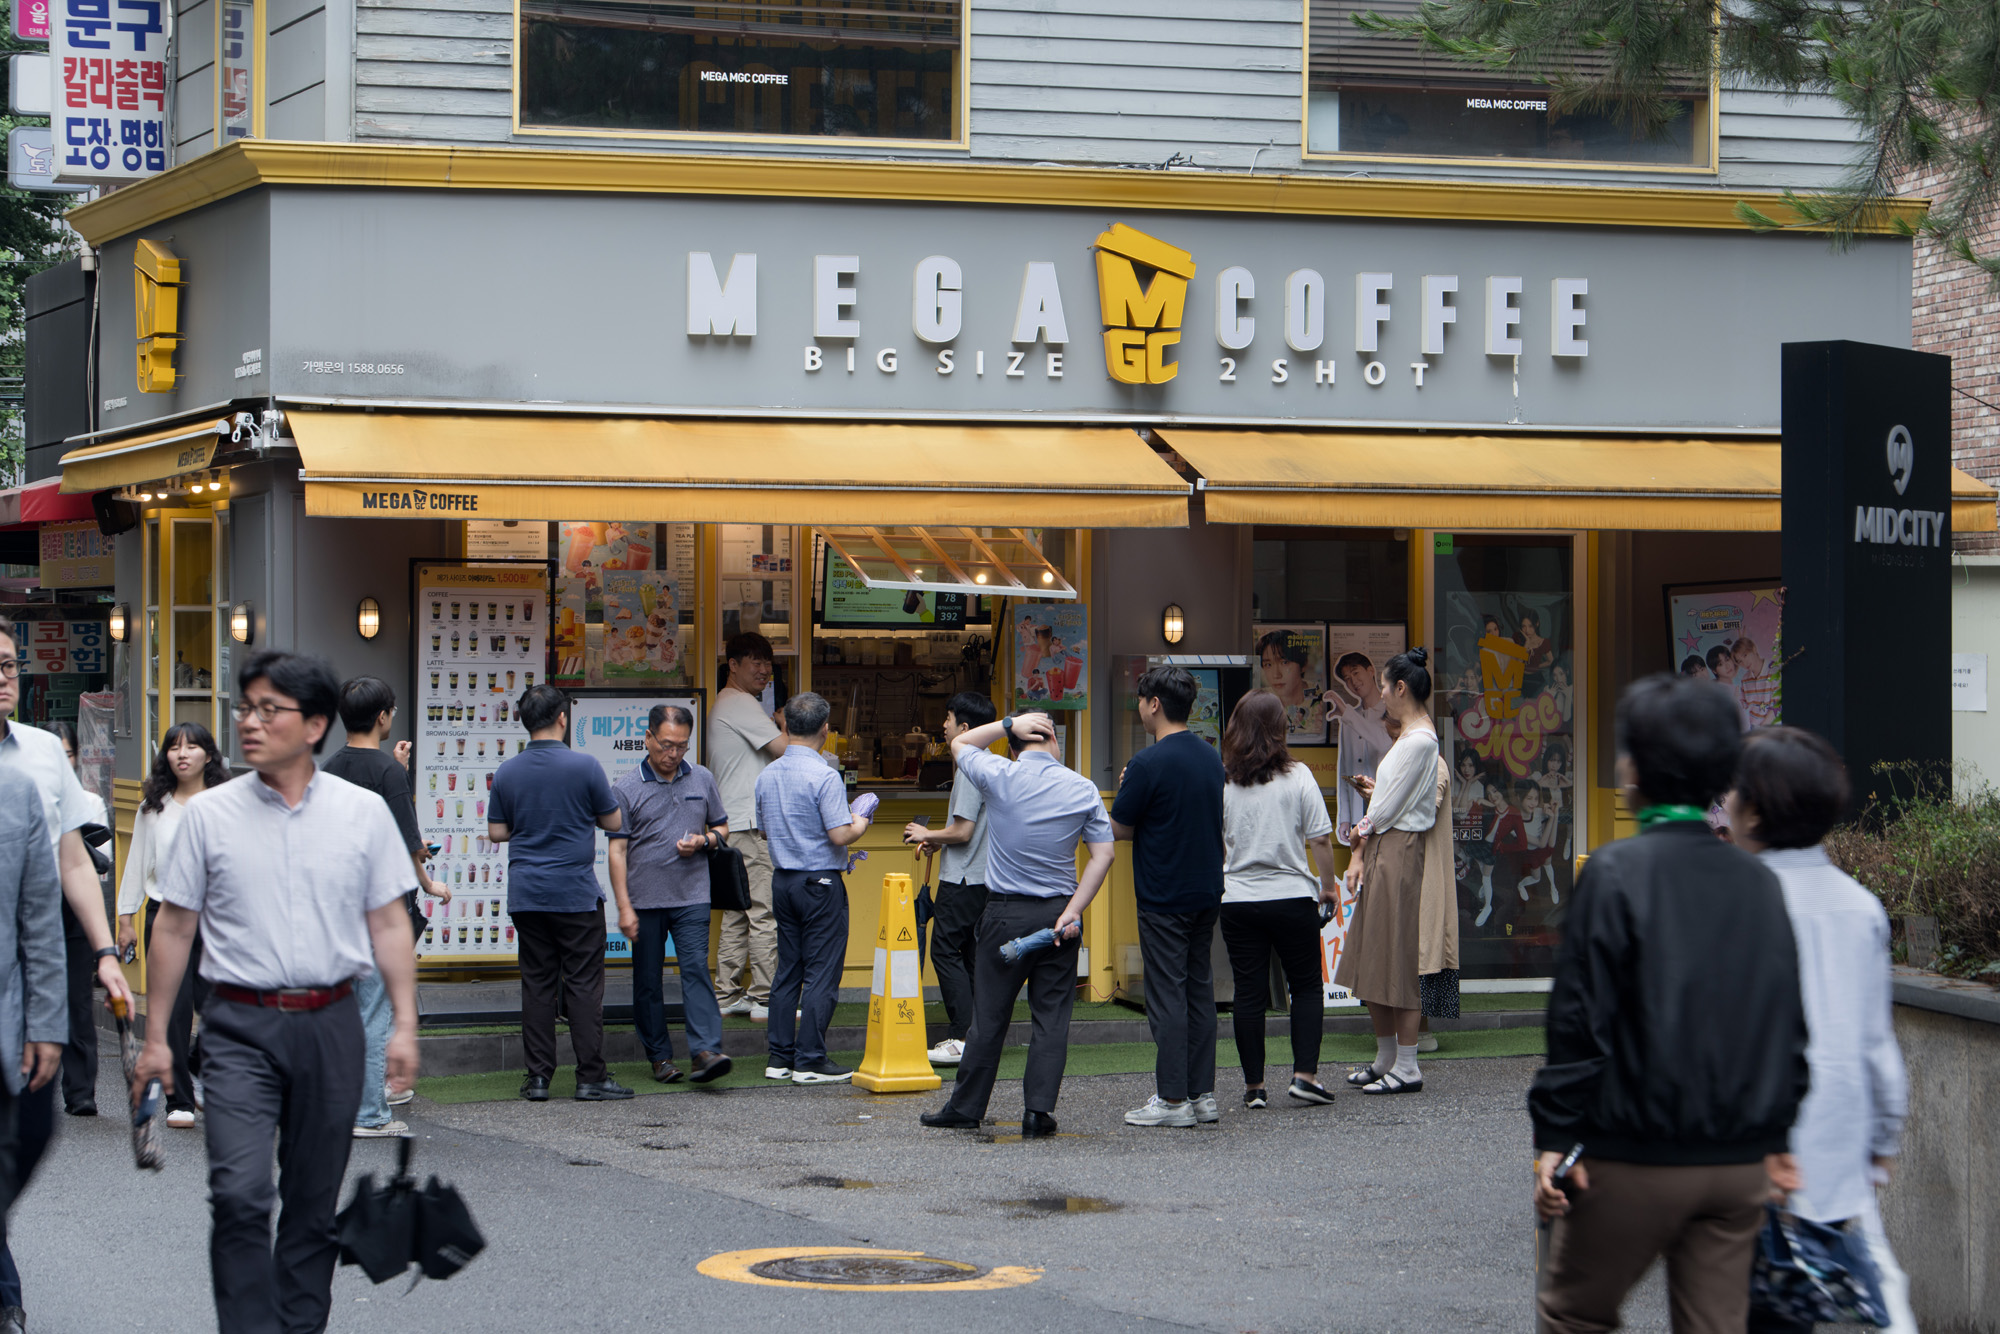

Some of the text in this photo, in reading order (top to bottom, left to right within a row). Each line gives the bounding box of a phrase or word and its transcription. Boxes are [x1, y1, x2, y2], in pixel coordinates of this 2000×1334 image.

[29, 2, 48, 24] 올
[65, 0, 162, 51] 문구
[63, 57, 164, 111] 칼라출력
[700, 71, 788, 85] MEGA MGC COFFEE
[1466, 98, 1547, 111] MEGA MGC COFFEE
[686, 251, 1588, 357] MEGA COFFEE
[302, 361, 404, 376] 가맹문의 1588.0656
[804, 346, 1429, 387] BIG SIZE 2 SHOT
[362, 492, 478, 511] MEGA COFFEE
[1855, 505, 1944, 548] MIDCITY
[945, 593, 956, 602] 78
[940, 612, 958, 621] 392
[34, 622, 68, 672] 코팅
[70, 622, 106, 673] 명함
[1328, 991, 1348, 1000] MEGA
